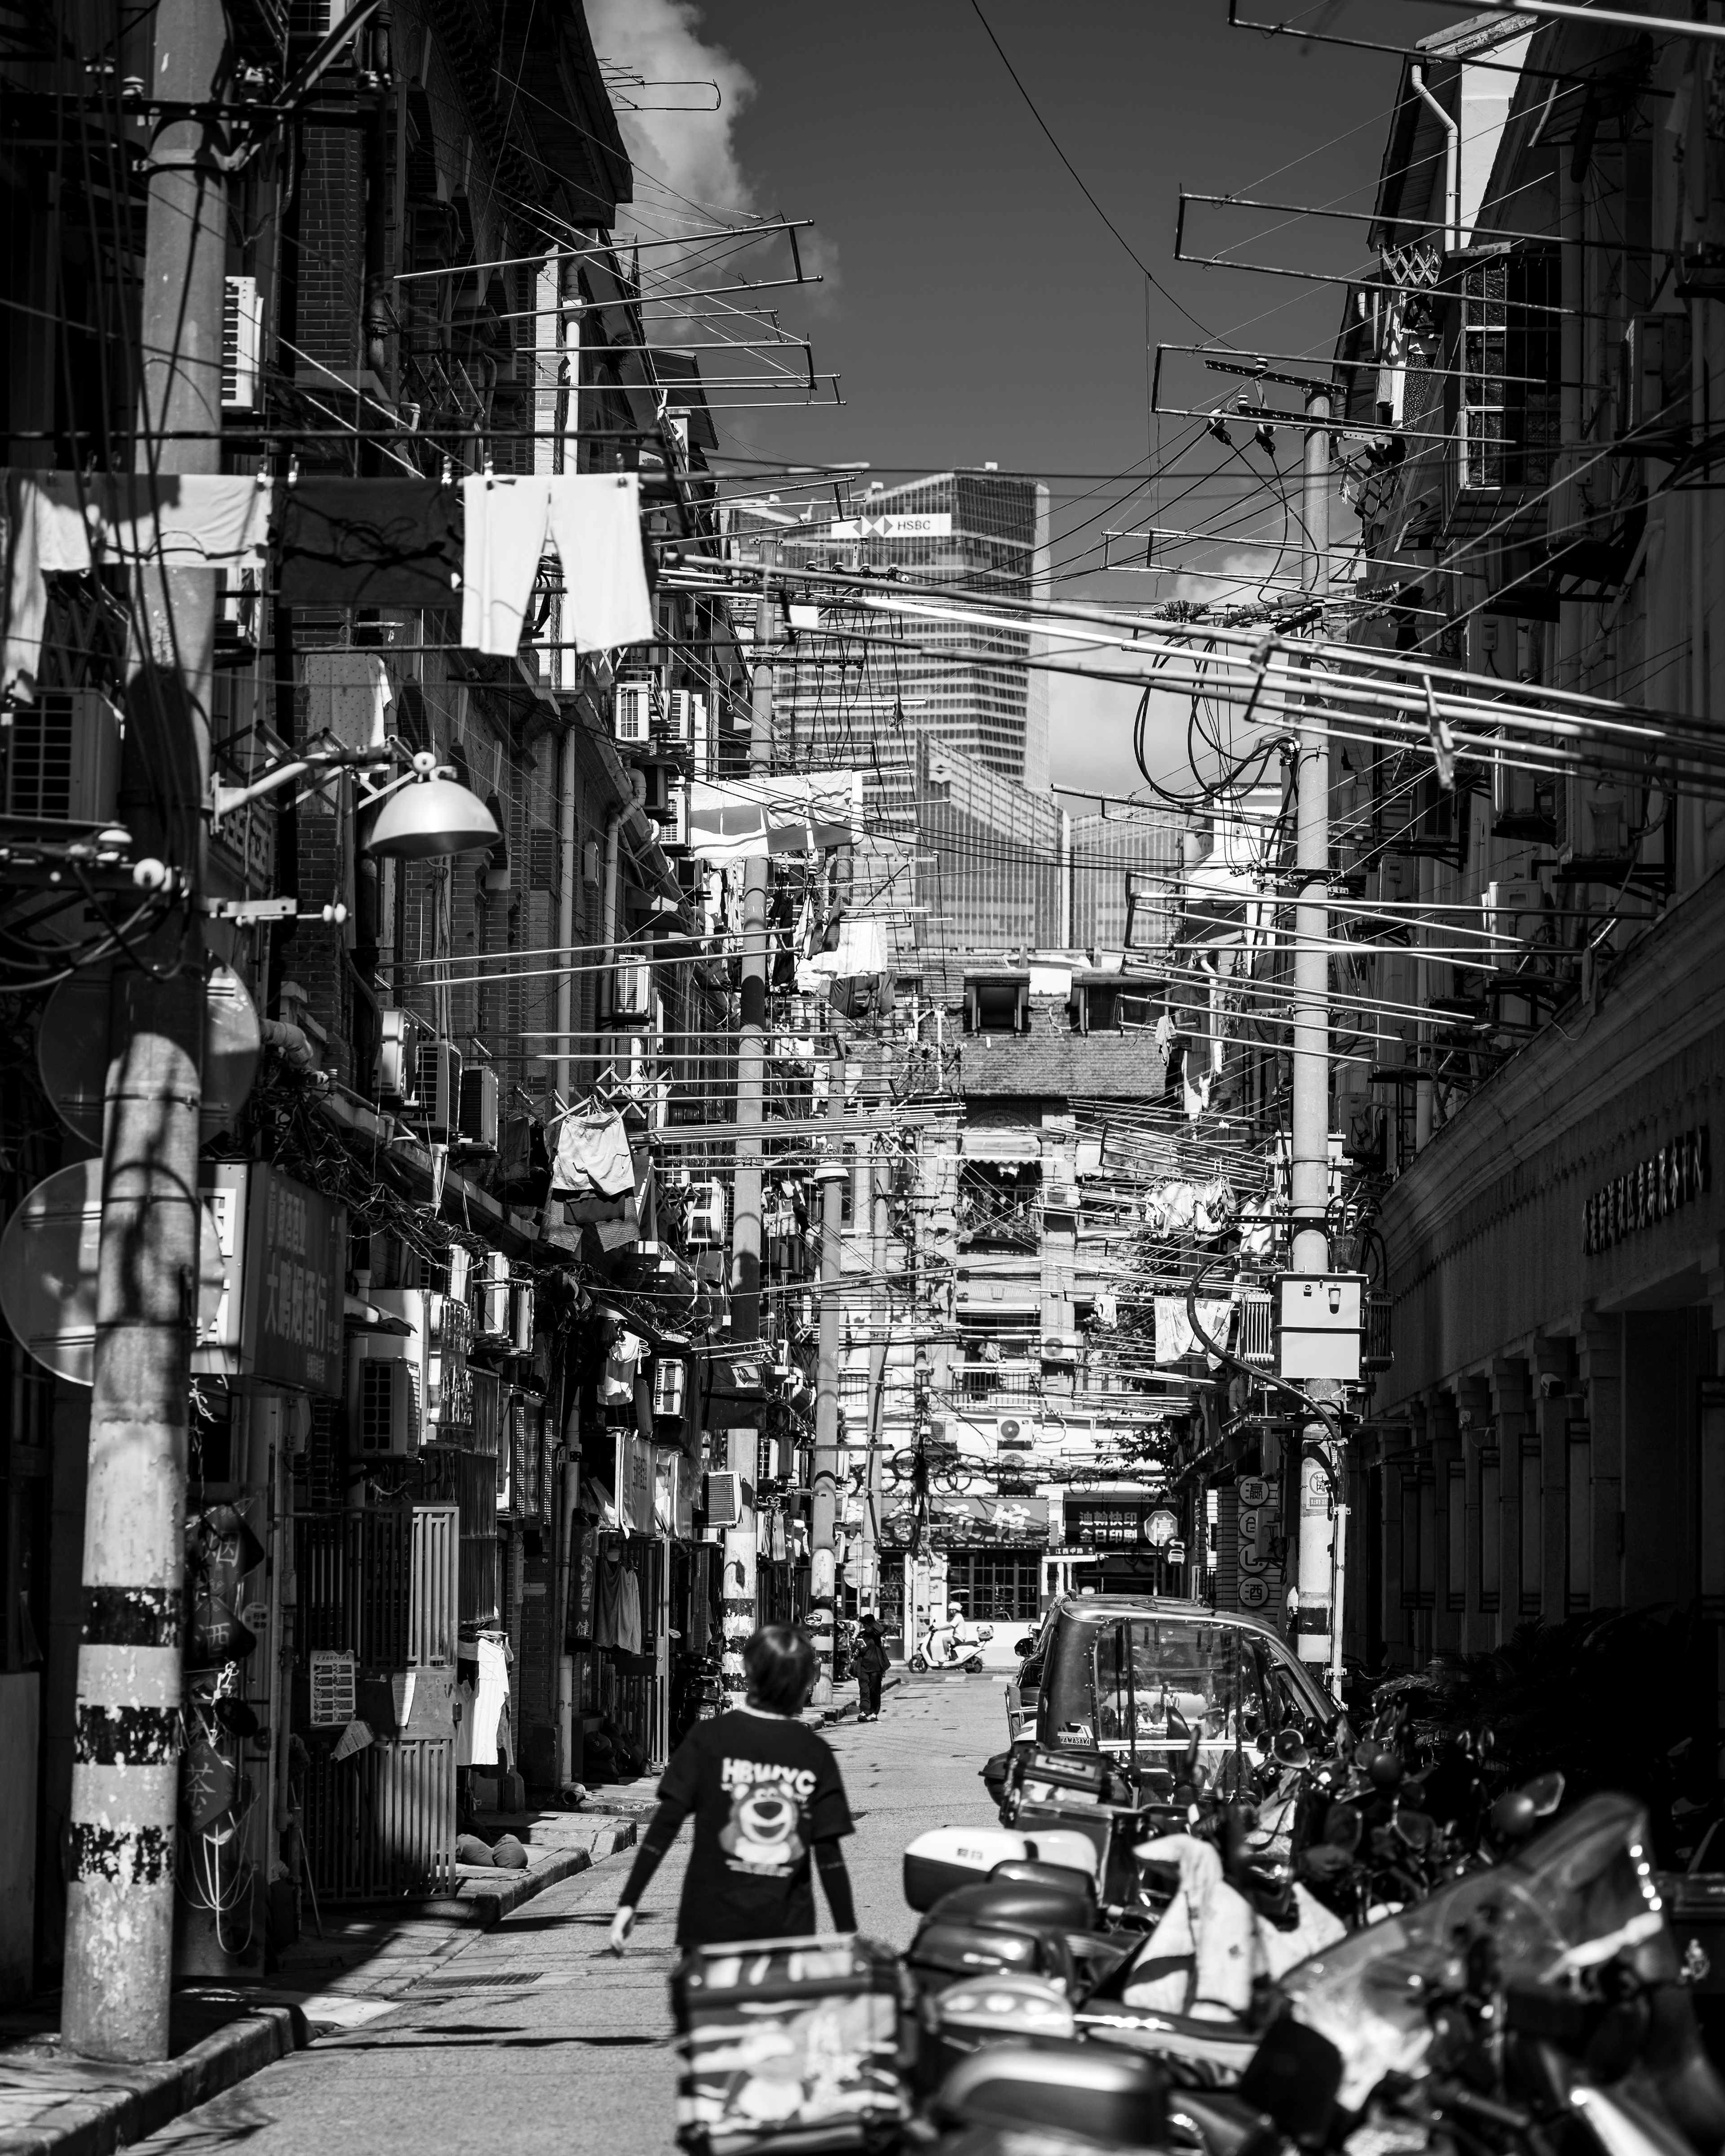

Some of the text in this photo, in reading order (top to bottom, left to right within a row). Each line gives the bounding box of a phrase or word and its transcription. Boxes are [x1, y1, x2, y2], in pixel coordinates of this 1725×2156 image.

[897, 520, 931, 531] HSBC
[1149, 1516, 1174, 1542] 停
[580, 1531, 593, 1548] 疗
[575, 1618, 590, 1637] 健
[194, 1622, 230, 1659] 酒
[1060, 1736, 1091, 1746] YAMASAKI
[181, 1762, 217, 1808] 茶
